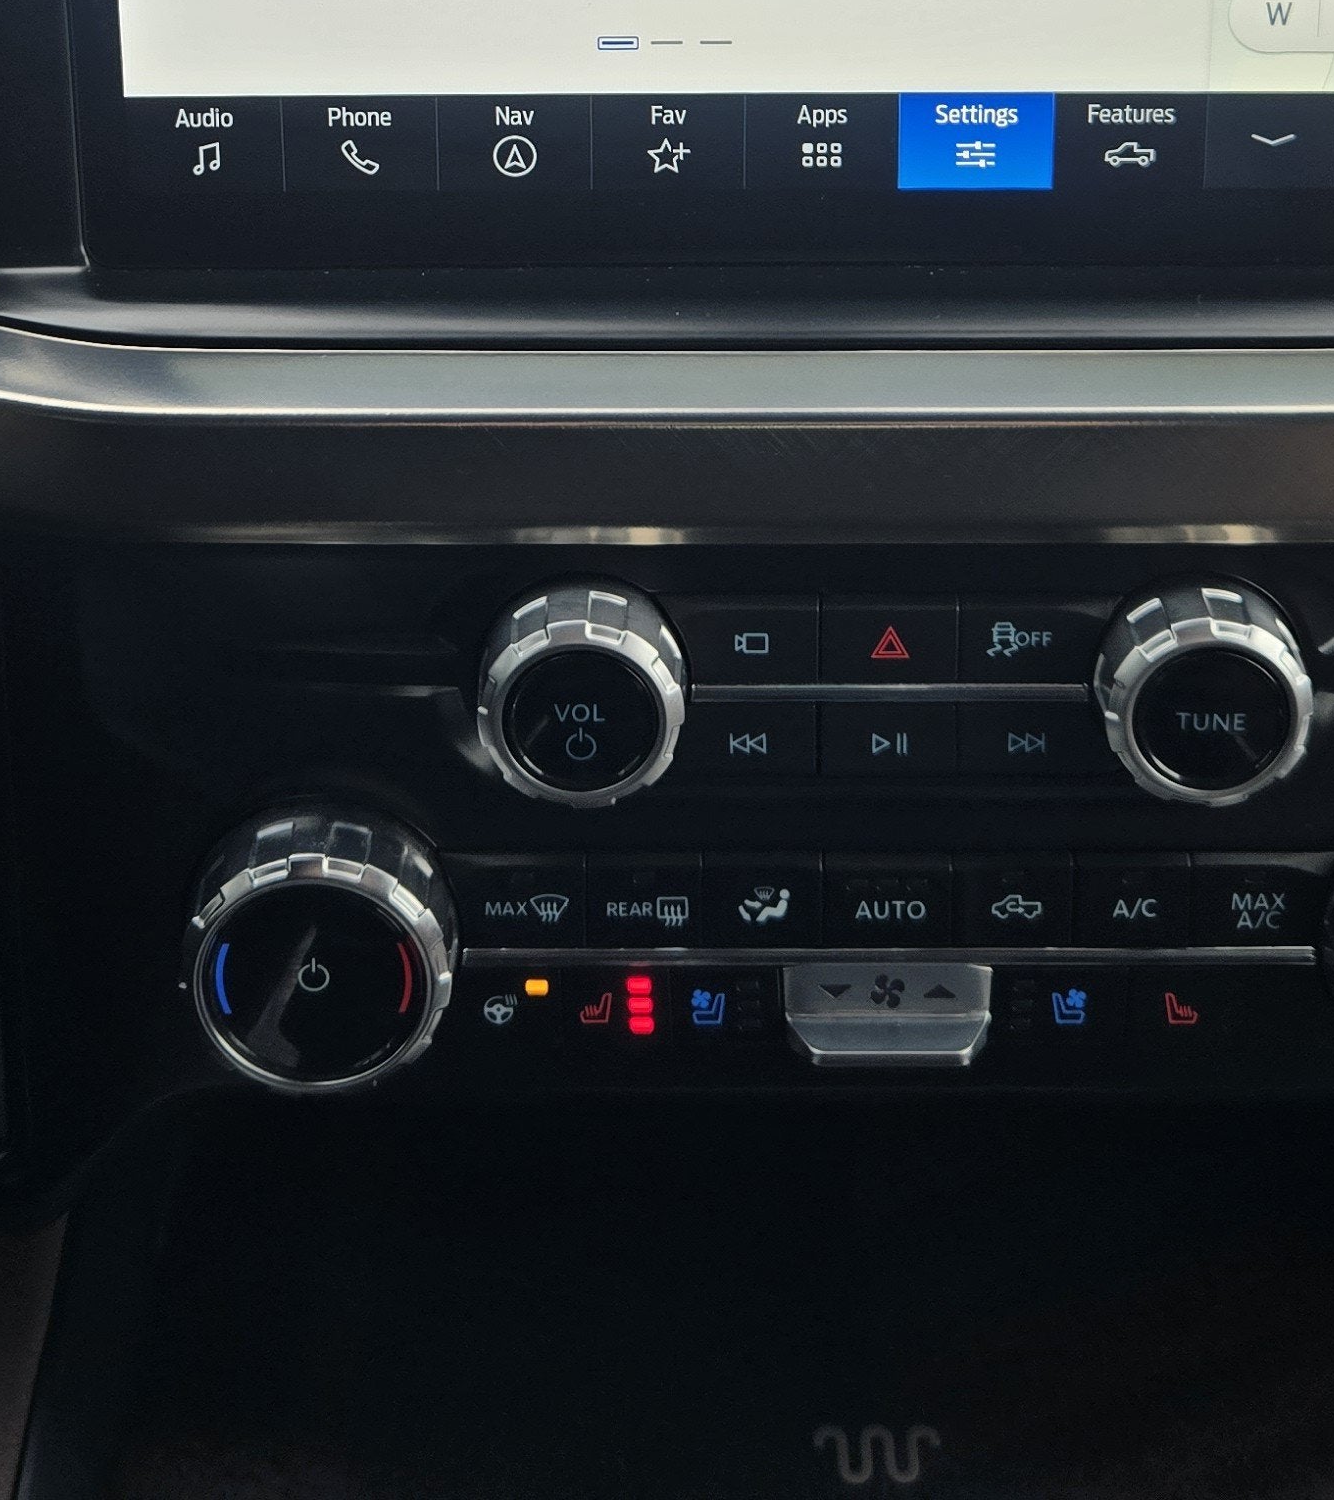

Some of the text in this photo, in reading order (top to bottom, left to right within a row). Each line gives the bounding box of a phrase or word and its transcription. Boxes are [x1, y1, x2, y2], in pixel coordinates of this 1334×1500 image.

[1267, 2, 1292, 25] W
[175, 108, 233, 128] Audio
[328, 107, 391, 126] Phone
[496, 106, 534, 125] Nav
[651, 105, 686, 124] Fav
[797, 105, 847, 127] Apps
[936, 104, 1018, 127] Settings
[1088, 103, 1175, 123] Features
[1016, 631, 1052, 647] OFF
[555, 704, 604, 722] VOL
[1177, 712, 1245, 731] TUNE
[485, 902, 527, 915] MAX
[607, 901, 652, 917] REAR
[855, 901, 926, 919] AUTO
[1113, 898, 1156, 918] A/C
[1232, 893, 1285, 911] MAX
[1237, 911, 1280, 930] A/C
